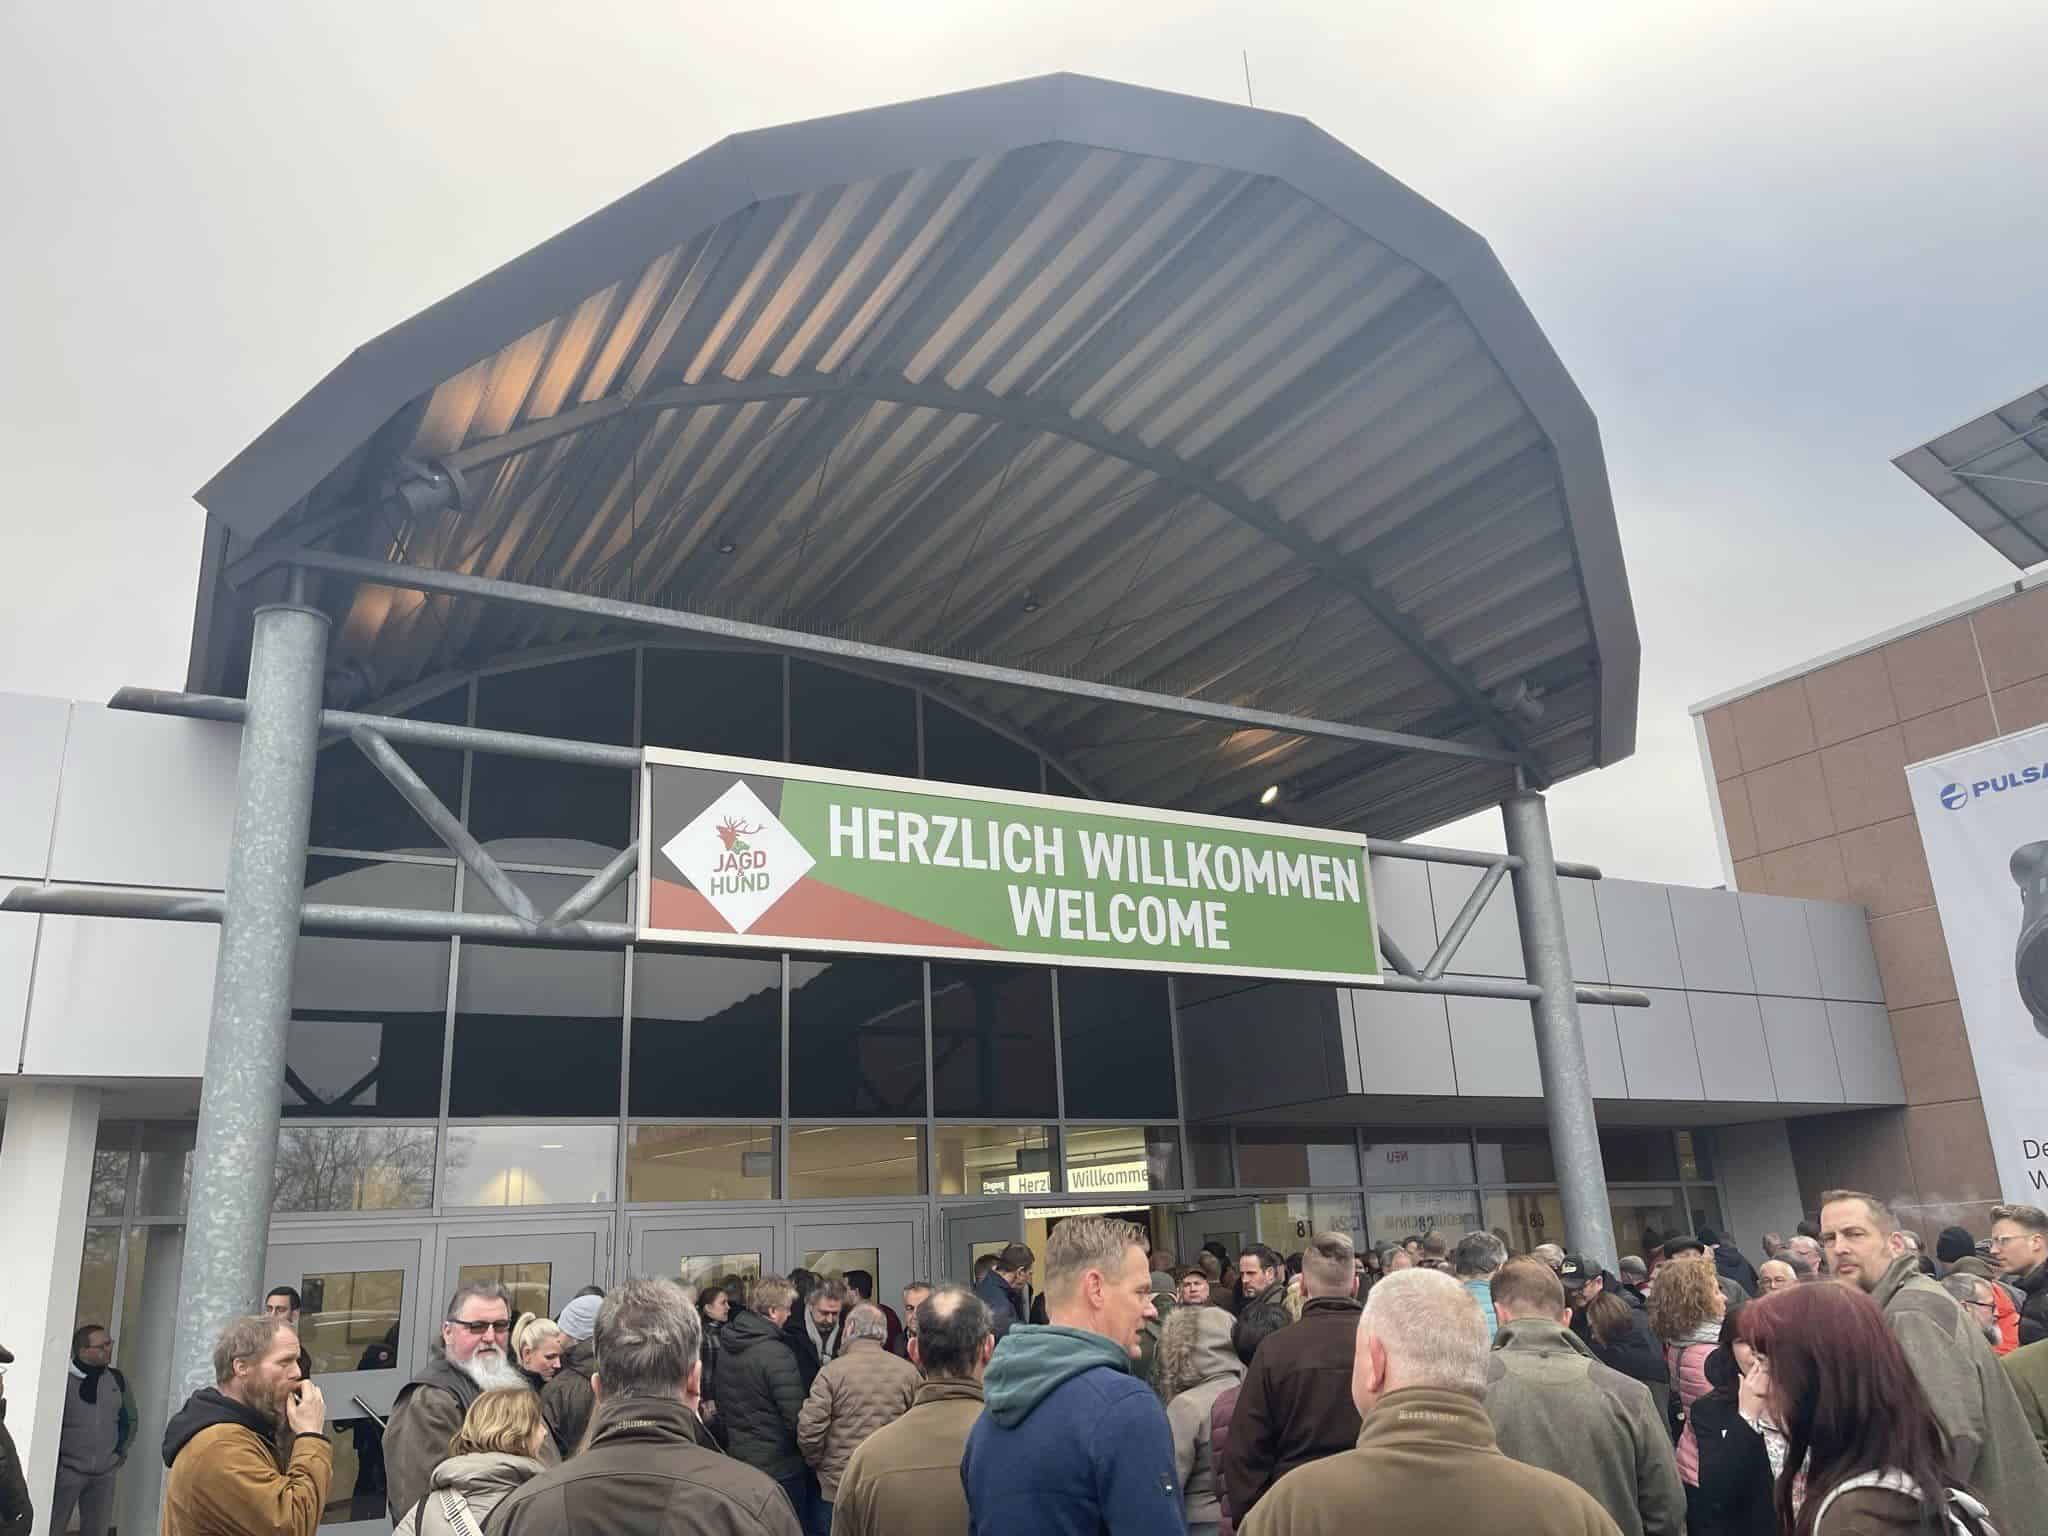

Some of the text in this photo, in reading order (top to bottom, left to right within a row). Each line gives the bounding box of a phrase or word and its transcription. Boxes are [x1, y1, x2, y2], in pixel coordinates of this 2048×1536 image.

[713, 850, 766, 872] JAGD
[829, 804, 1361, 904] HERZLICH WILLKOMMEN
[710, 872, 770, 896] HUND
[1008, 884, 1231, 951] WELCOME
[1296, 1220, 1313, 1238] 81
